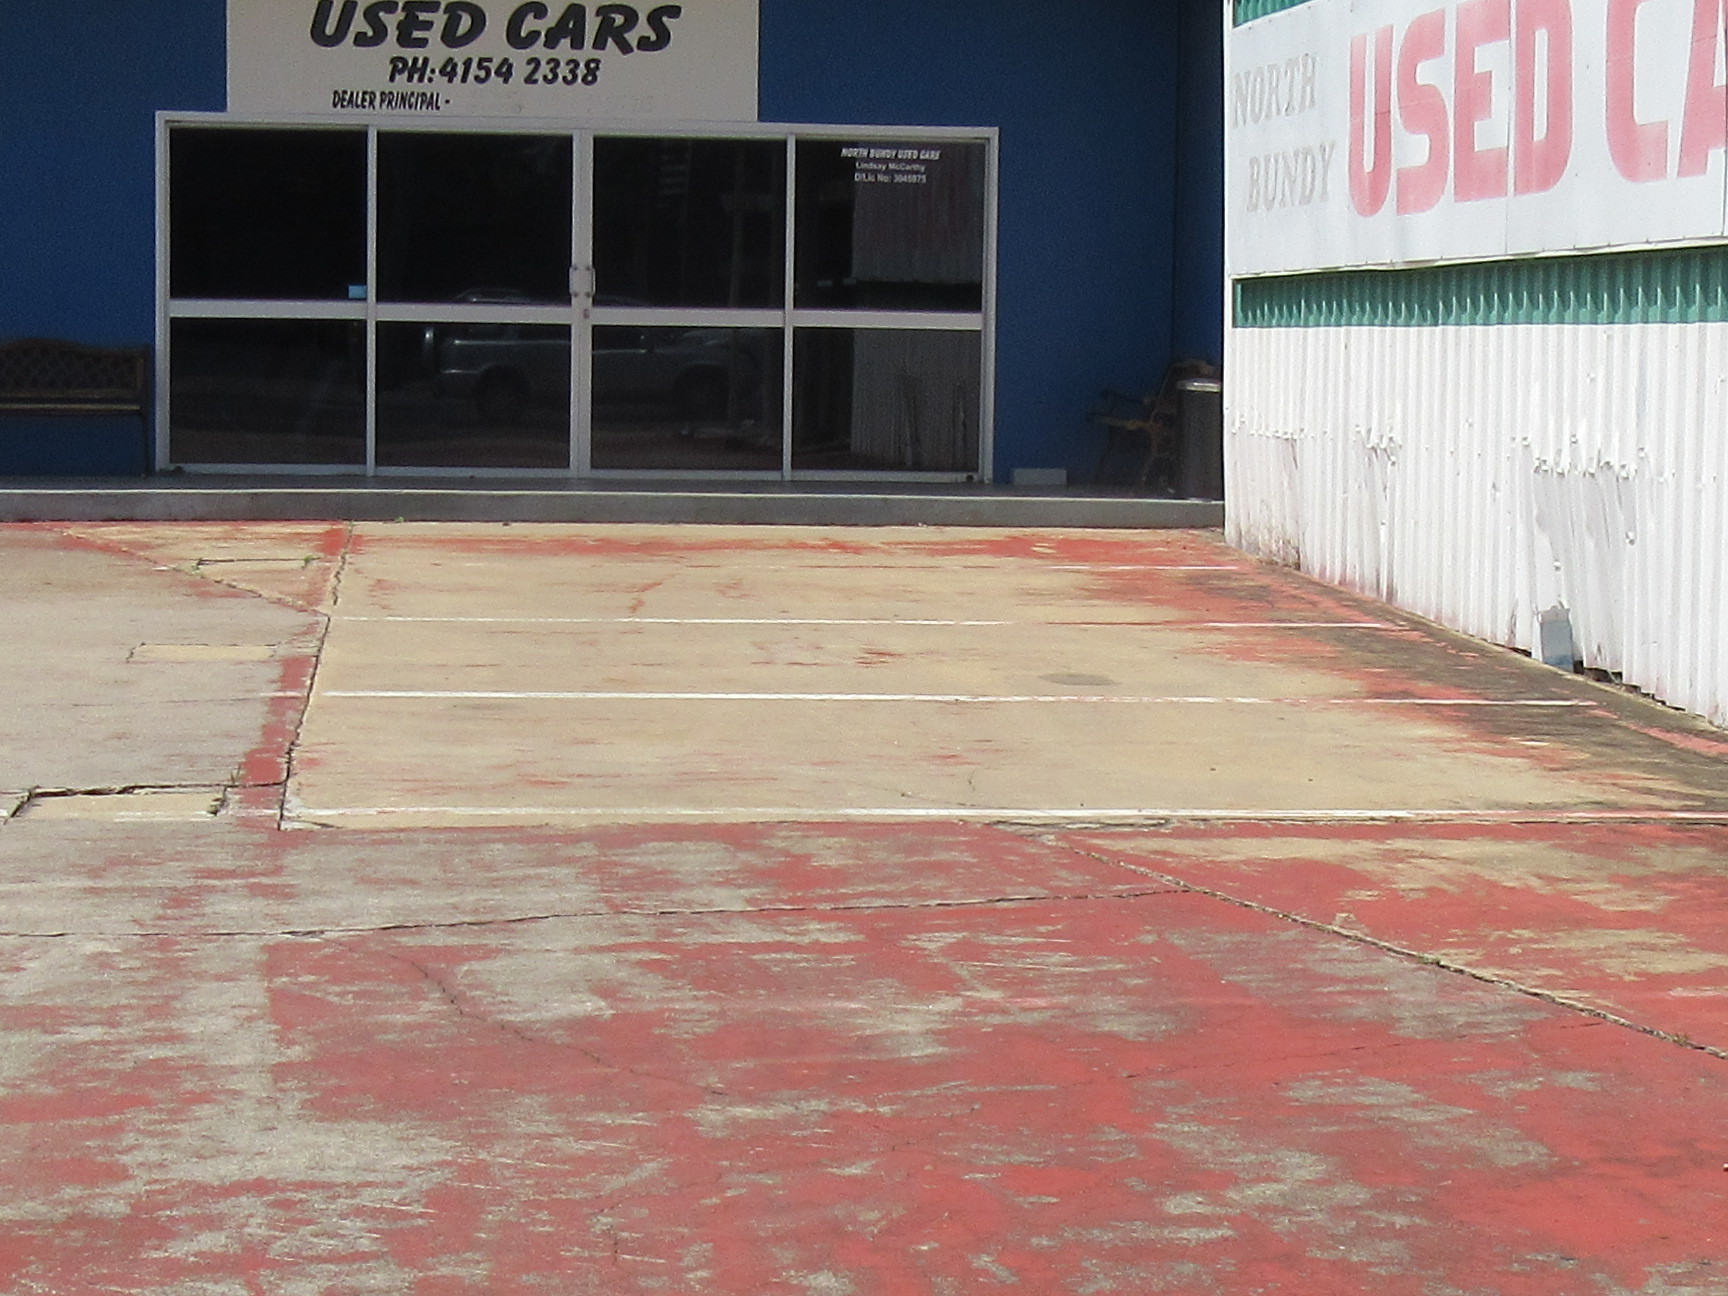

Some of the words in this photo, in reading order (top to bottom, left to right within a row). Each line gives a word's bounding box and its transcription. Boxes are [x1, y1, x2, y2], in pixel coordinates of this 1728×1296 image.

[505, 2, 682, 55] CARS
[523, 57, 601, 86] 2338
[1231, 53, 1317, 129] NORTH
[332, 90, 377, 110] DEALER
[379, 90, 441, 111] PRINCIPAL
[1245, 140, 1335, 212] BUNDY
